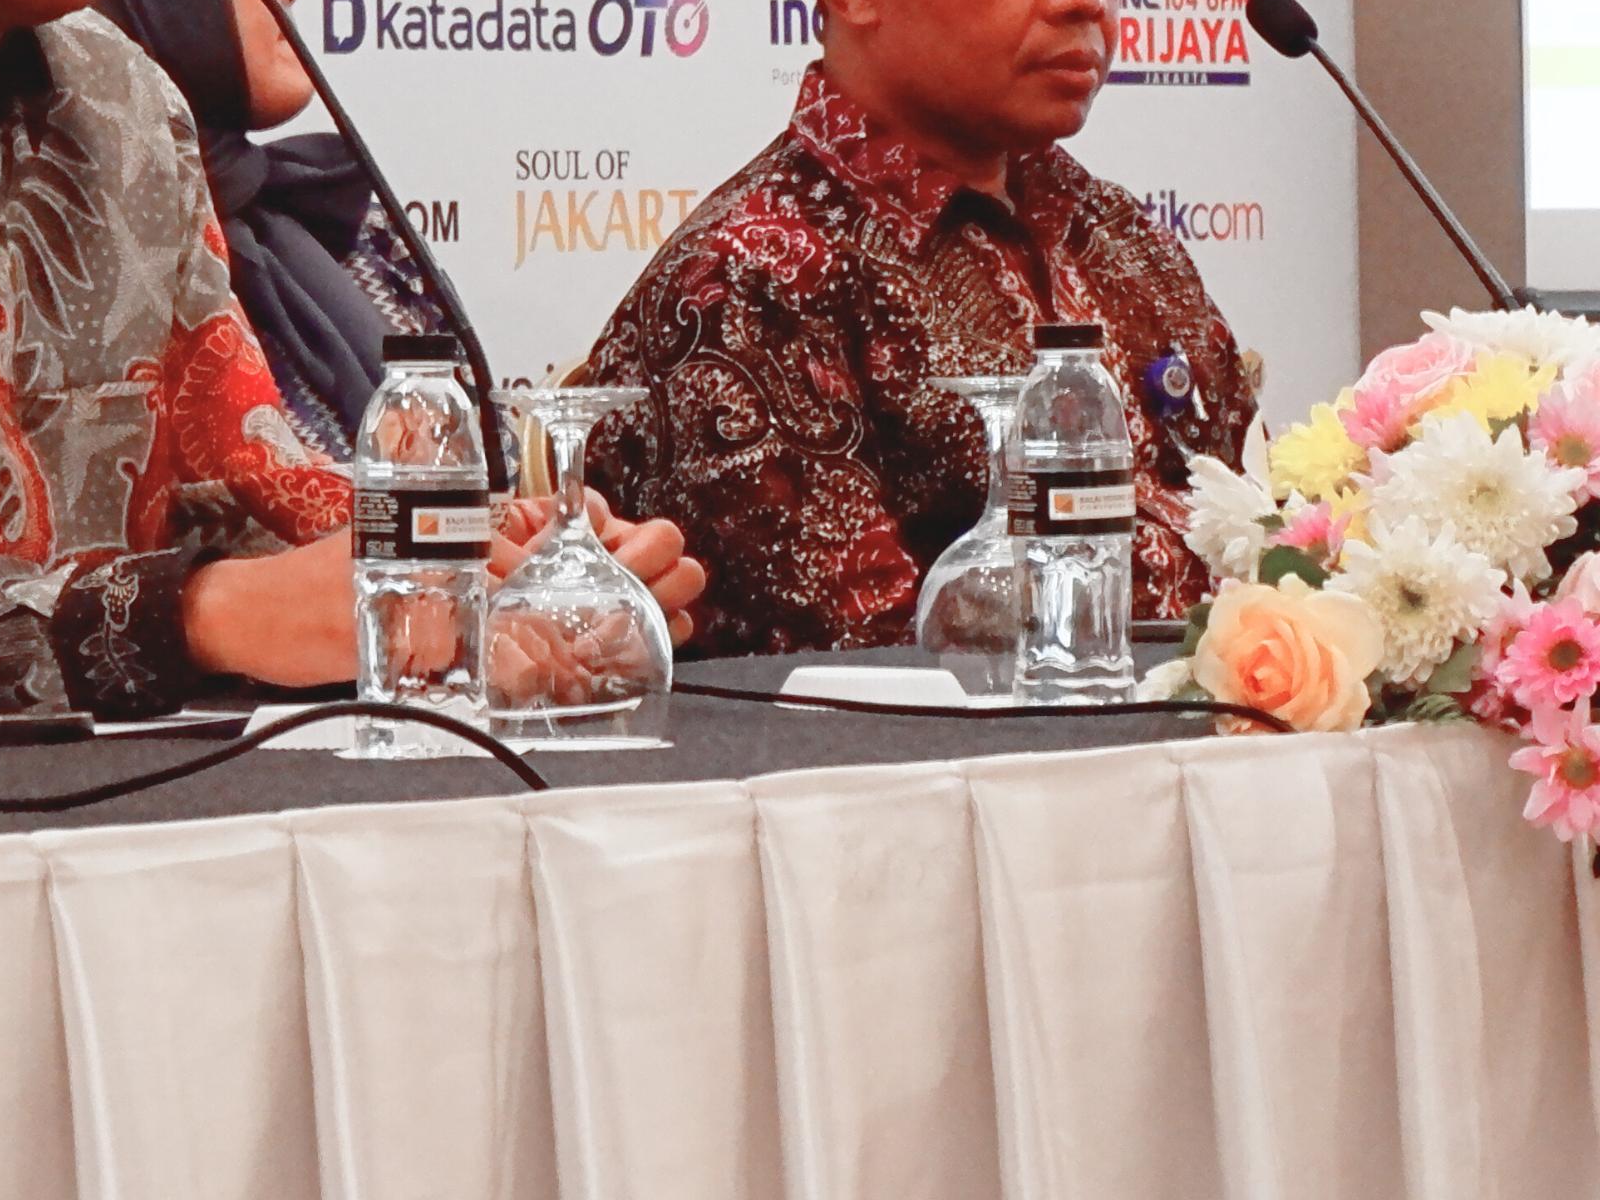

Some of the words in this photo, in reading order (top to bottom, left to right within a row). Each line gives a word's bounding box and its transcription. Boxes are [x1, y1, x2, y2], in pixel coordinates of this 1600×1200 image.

[1120, 17, 1249, 64] RIJAYA
[516, 150, 588, 181] SOUL
[595, 150, 630, 181] OF
